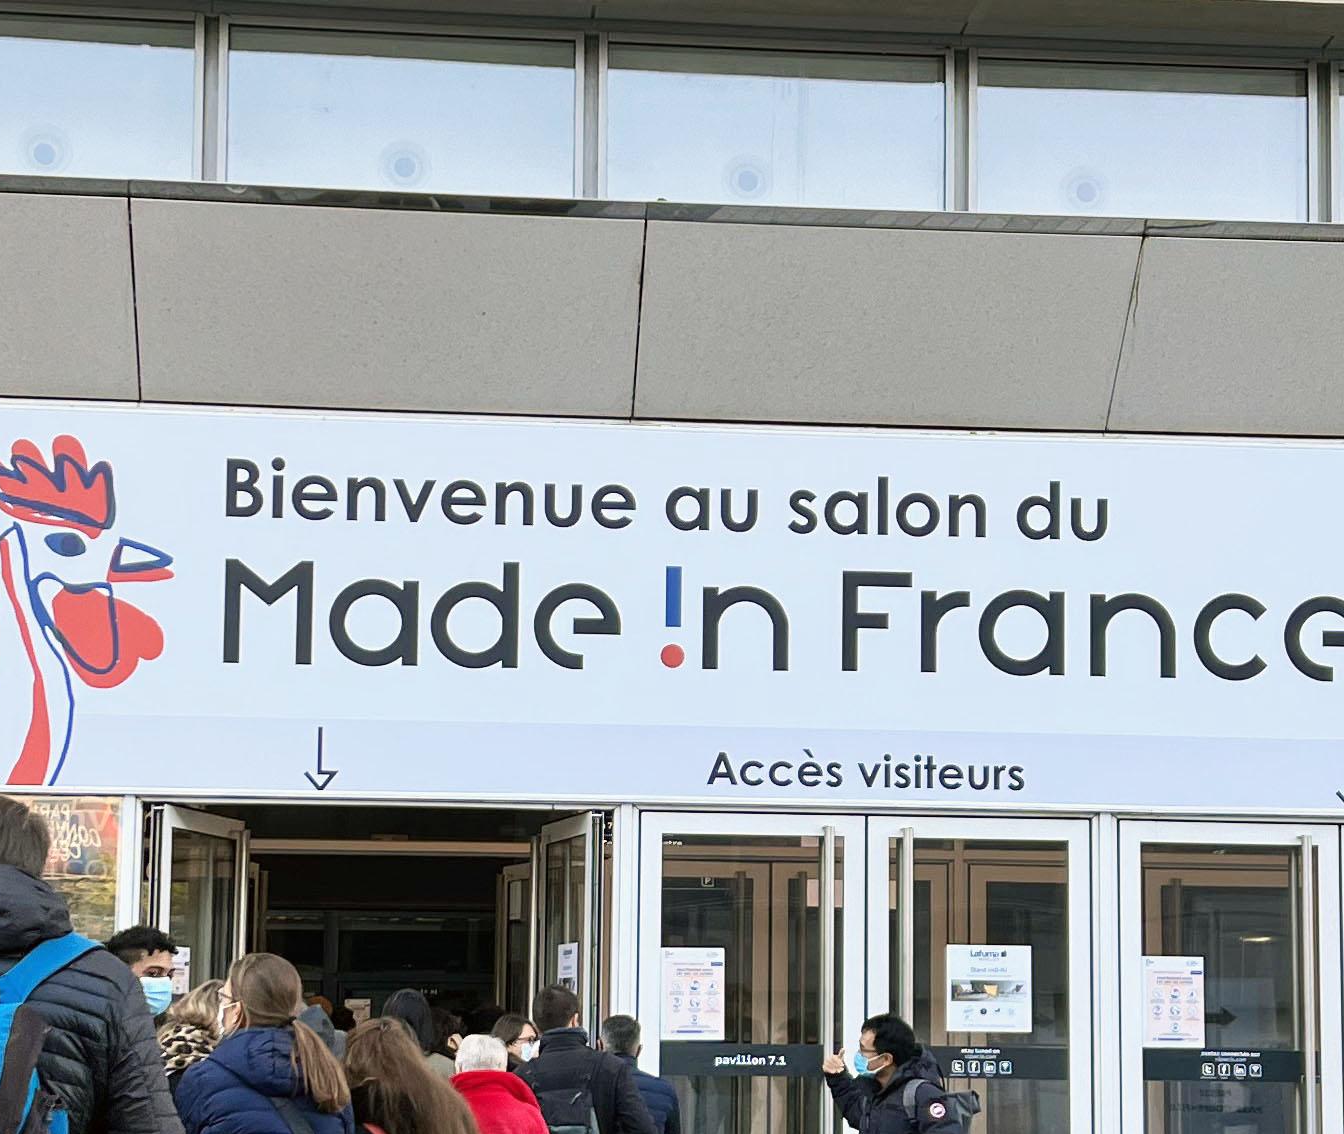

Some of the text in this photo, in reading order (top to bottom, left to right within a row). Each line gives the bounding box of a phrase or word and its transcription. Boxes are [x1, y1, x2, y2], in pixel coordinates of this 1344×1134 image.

[225, 457, 1108, 542] Bienvenue au salon du
[222, 558, 622, 670] Made
[706, 748, 1025, 792] Accès visiteurs
[715, 1054, 786, 1067] pavilion 7.1
